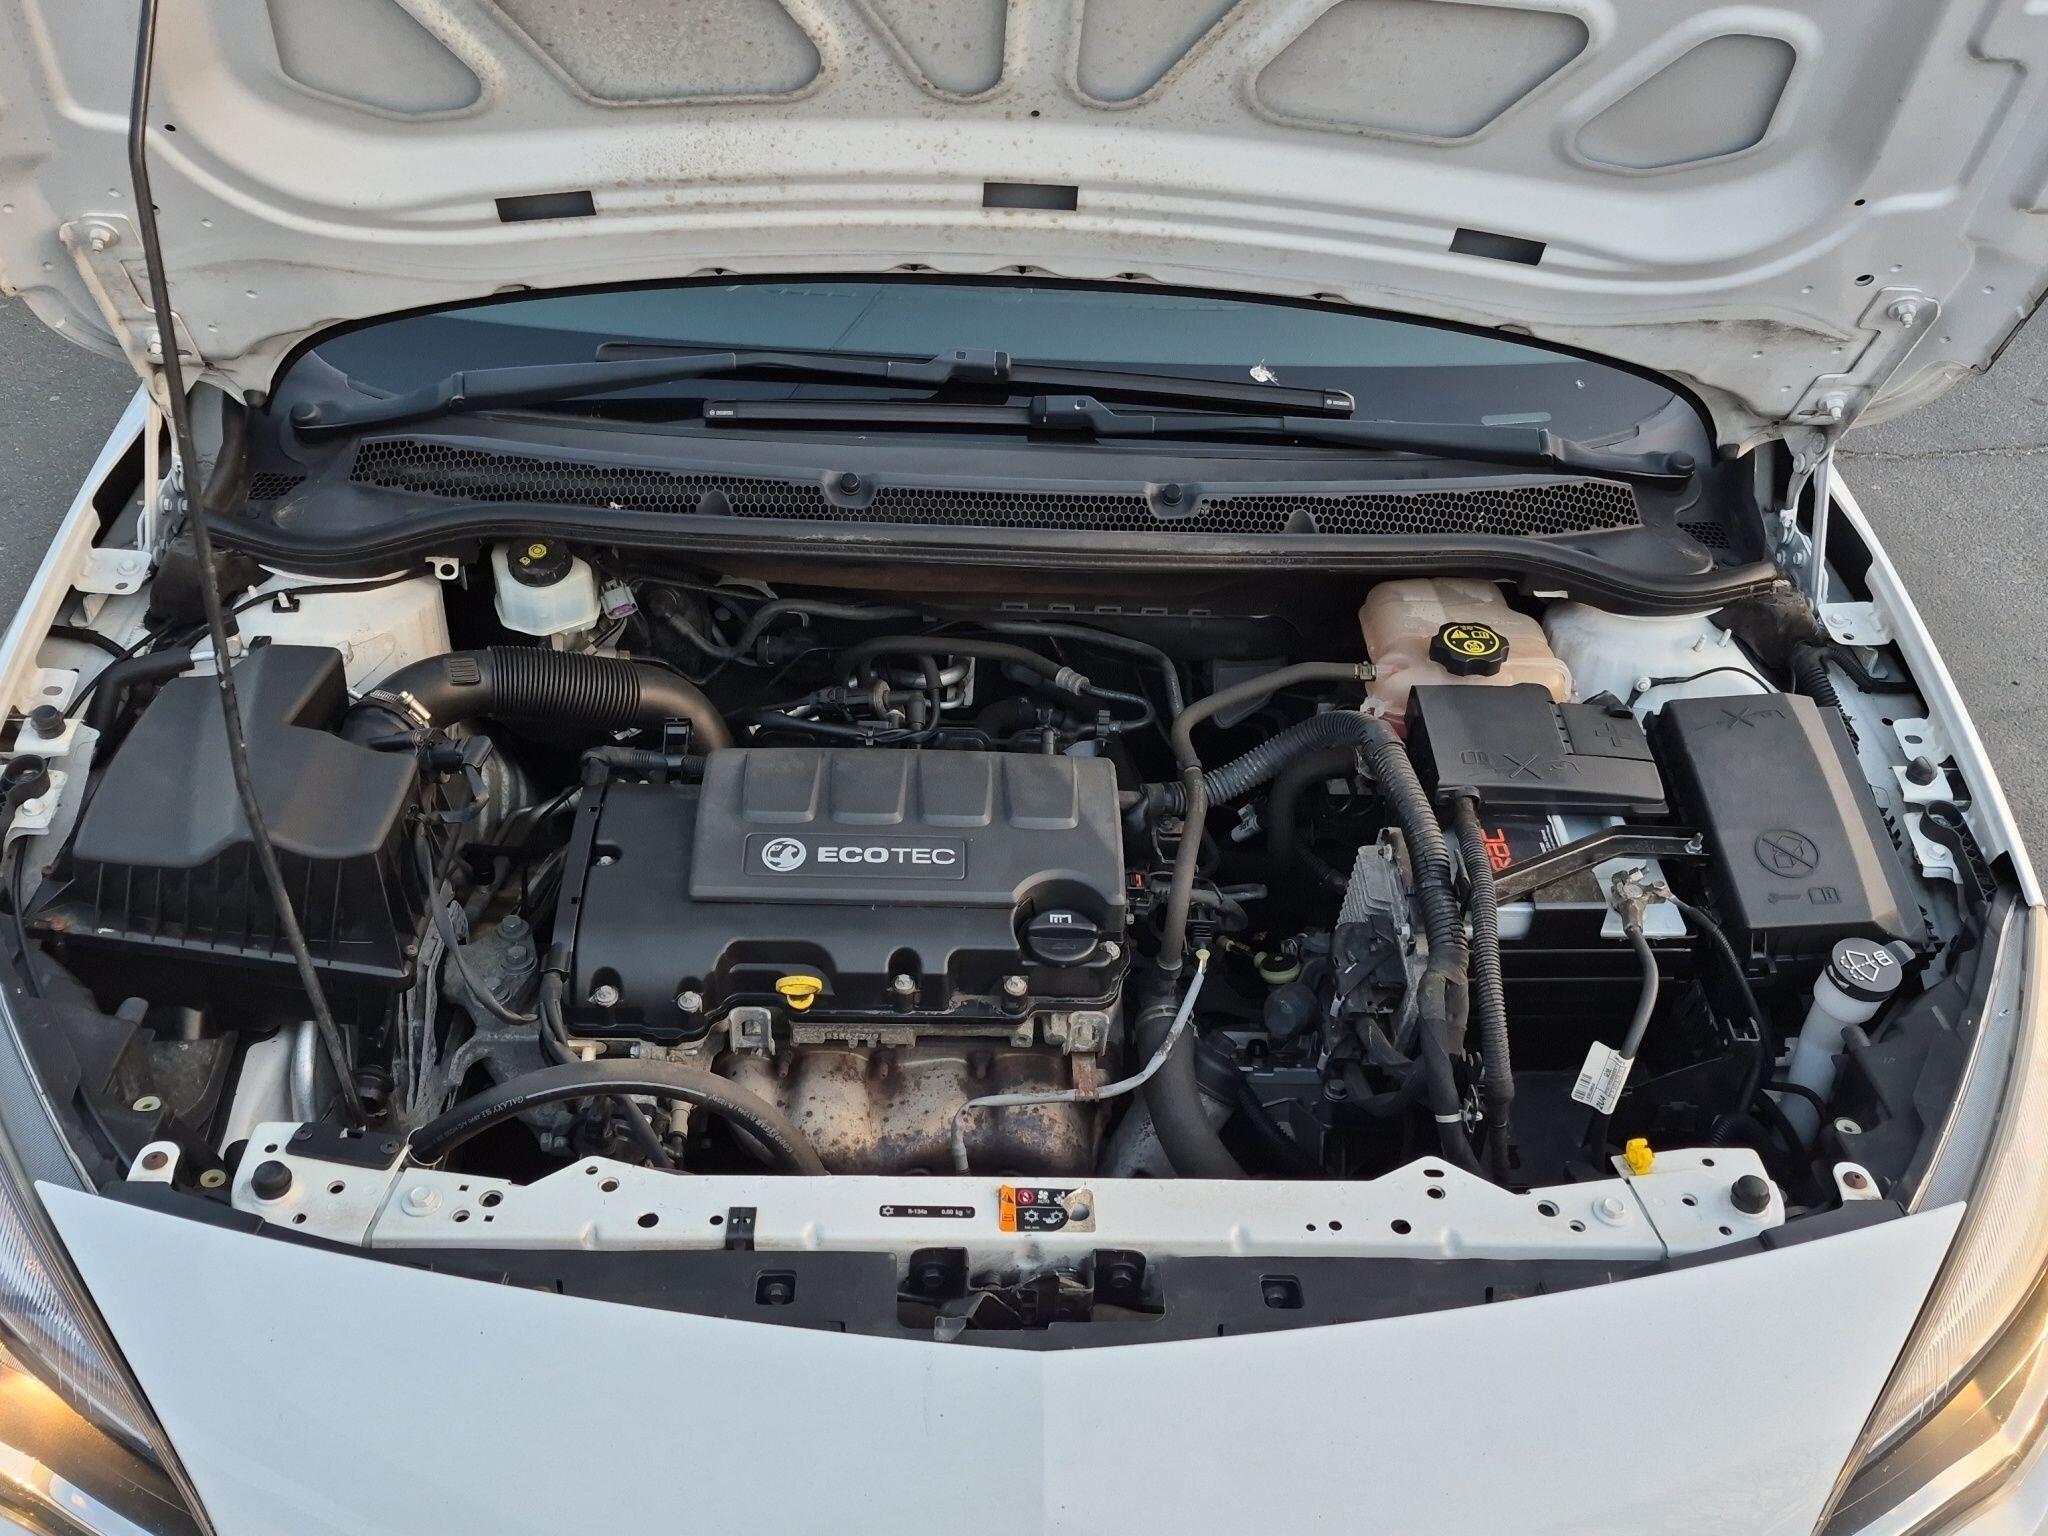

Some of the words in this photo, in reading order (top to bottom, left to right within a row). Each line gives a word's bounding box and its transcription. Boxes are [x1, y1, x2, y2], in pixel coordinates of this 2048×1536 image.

[817, 846, 956, 865] ECOTEC
[493, 1095, 524, 1113] GALAXY
[955, 1208, 963, 1217] kg
